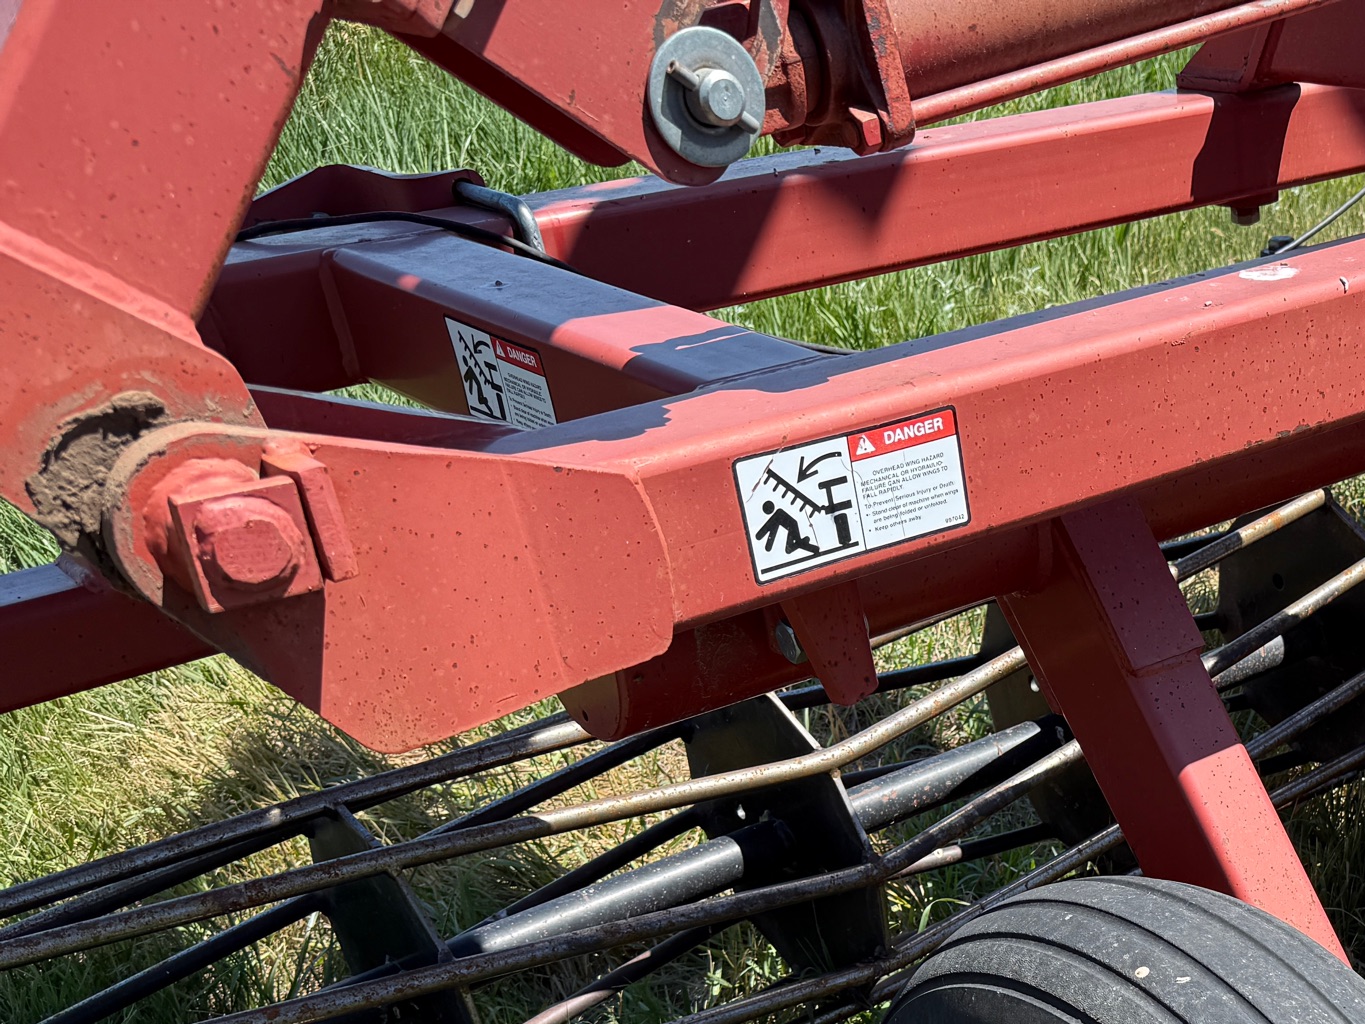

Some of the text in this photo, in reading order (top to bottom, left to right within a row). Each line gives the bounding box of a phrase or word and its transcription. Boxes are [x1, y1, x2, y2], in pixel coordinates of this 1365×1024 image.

[507, 346, 537, 368] DANGER
[883, 417, 943, 444] DANGER
[872, 452, 944, 476] OVERHEAD WING HAZARD
[860, 472, 899, 486] MECHANICAL
[861, 482, 886, 493] FAILURE
[901, 473, 922, 482] ALLOW
[922, 468, 940, 476] WINGS
[873, 498, 893, 507] Prevent
[895, 492, 915, 501] Serious
[917, 488, 931, 496] Injury
[909, 497, 929, 506] machine
